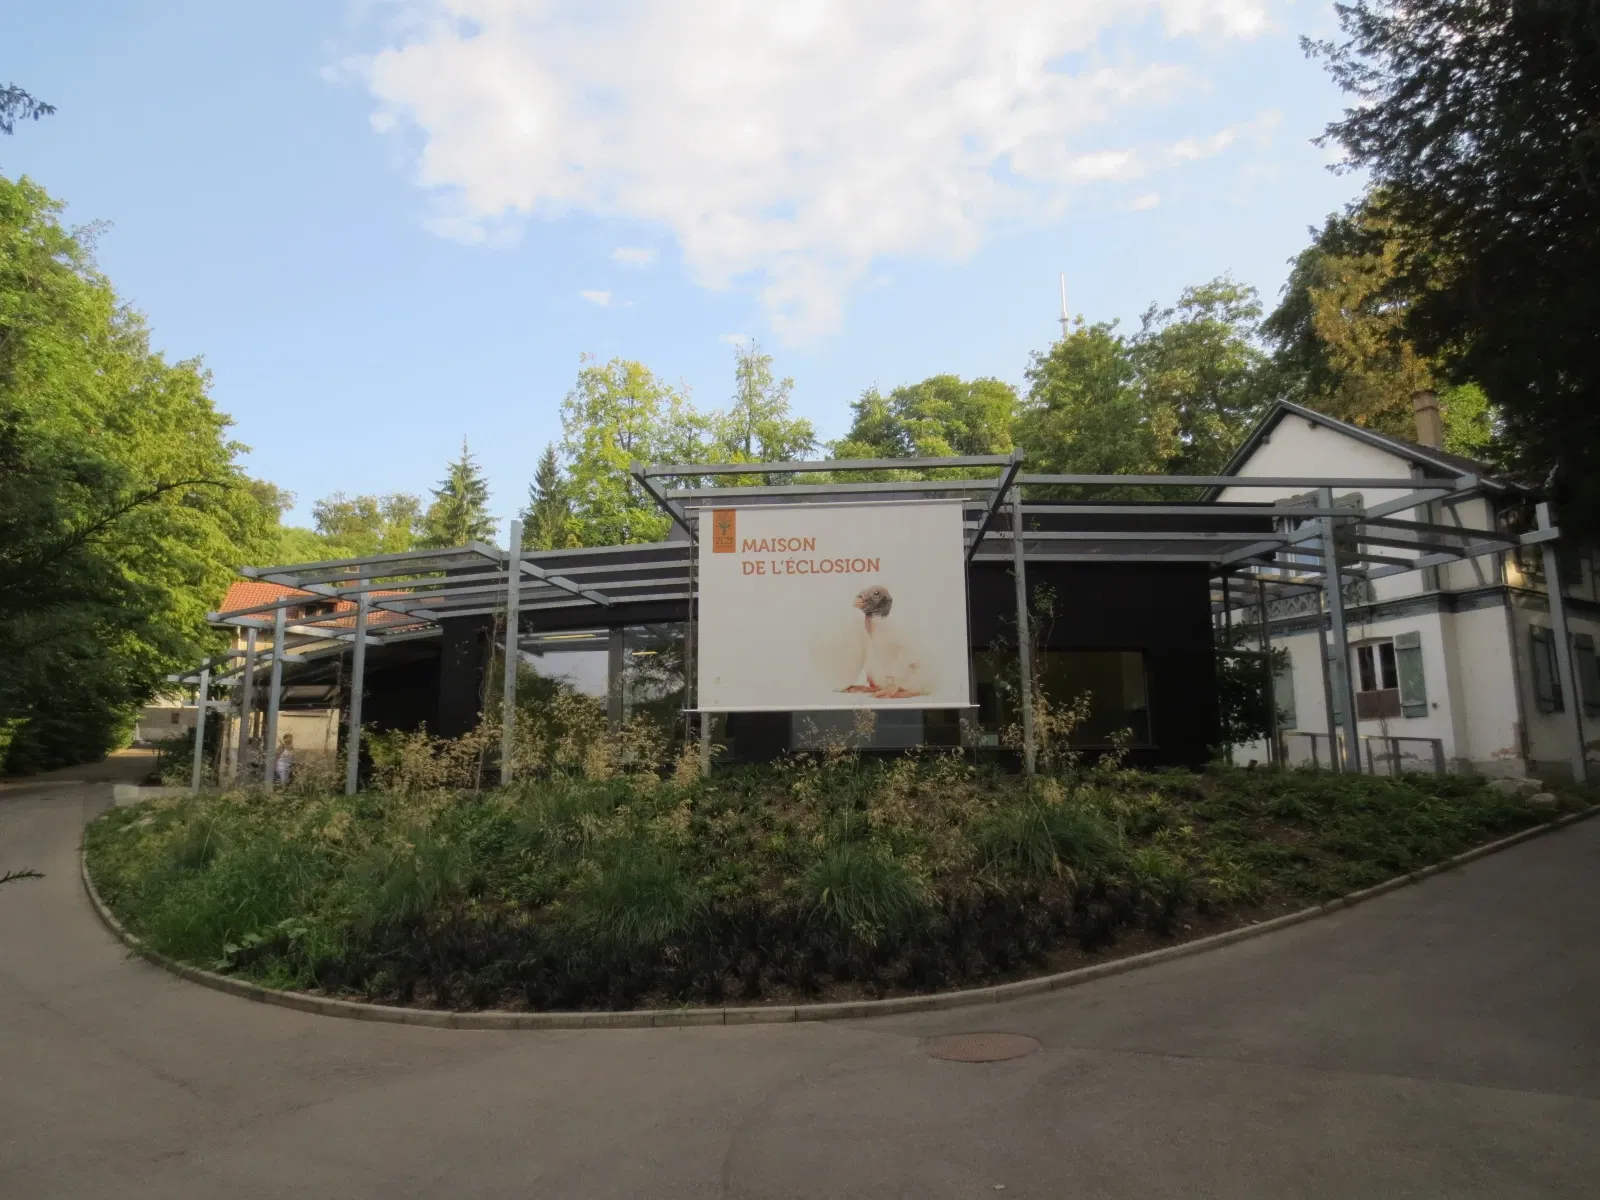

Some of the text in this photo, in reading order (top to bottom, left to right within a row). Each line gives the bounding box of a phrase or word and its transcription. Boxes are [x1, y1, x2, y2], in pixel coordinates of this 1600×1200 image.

[742, 537, 816, 553] MAISON
[742, 557, 881, 575] DE L'ÉCLOSION
